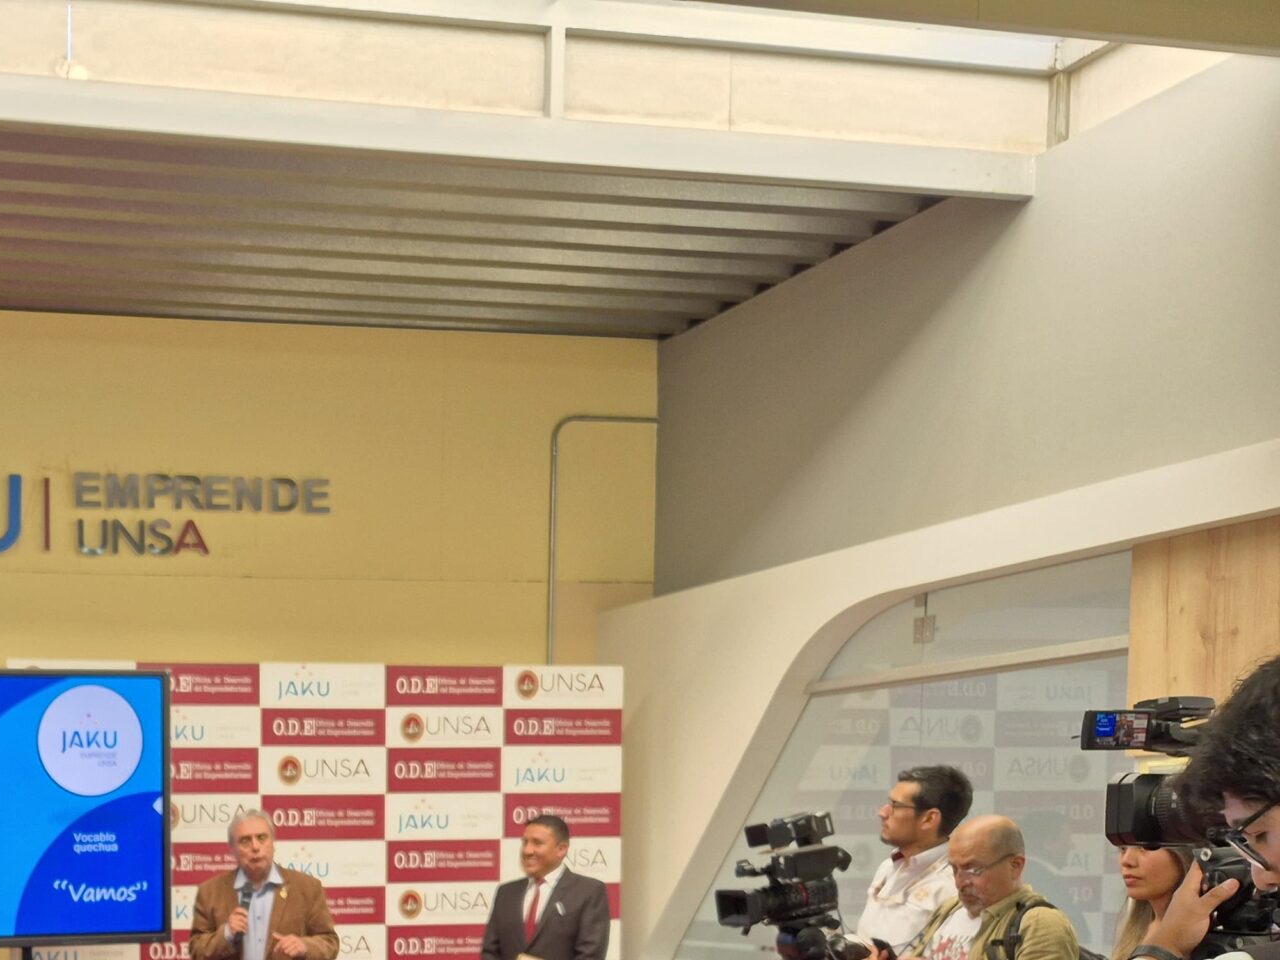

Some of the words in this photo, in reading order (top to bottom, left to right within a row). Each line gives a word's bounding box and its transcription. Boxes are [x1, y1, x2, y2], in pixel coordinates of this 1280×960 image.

[73, 470, 331, 515] EMPRENDE
[76, 517, 209, 556] UNSA
[278, 681, 330, 700] JAKU
[540, 673, 604, 692] UNSA
[174, 725, 204, 740] KU
[425, 716, 491, 735] UNSA
[61, 730, 117, 753] JAKU
[304, 759, 370, 778] UNSA
[515, 768, 565, 786] JAKU
[398, 814, 449, 833] JAKU
[73, 832, 116, 843] Vocablo
[73, 842, 118, 854] quechua
[563, 849, 607, 868] NSA
[423, 892, 488, 912] UNSA
[340, 935, 372, 954] SA
